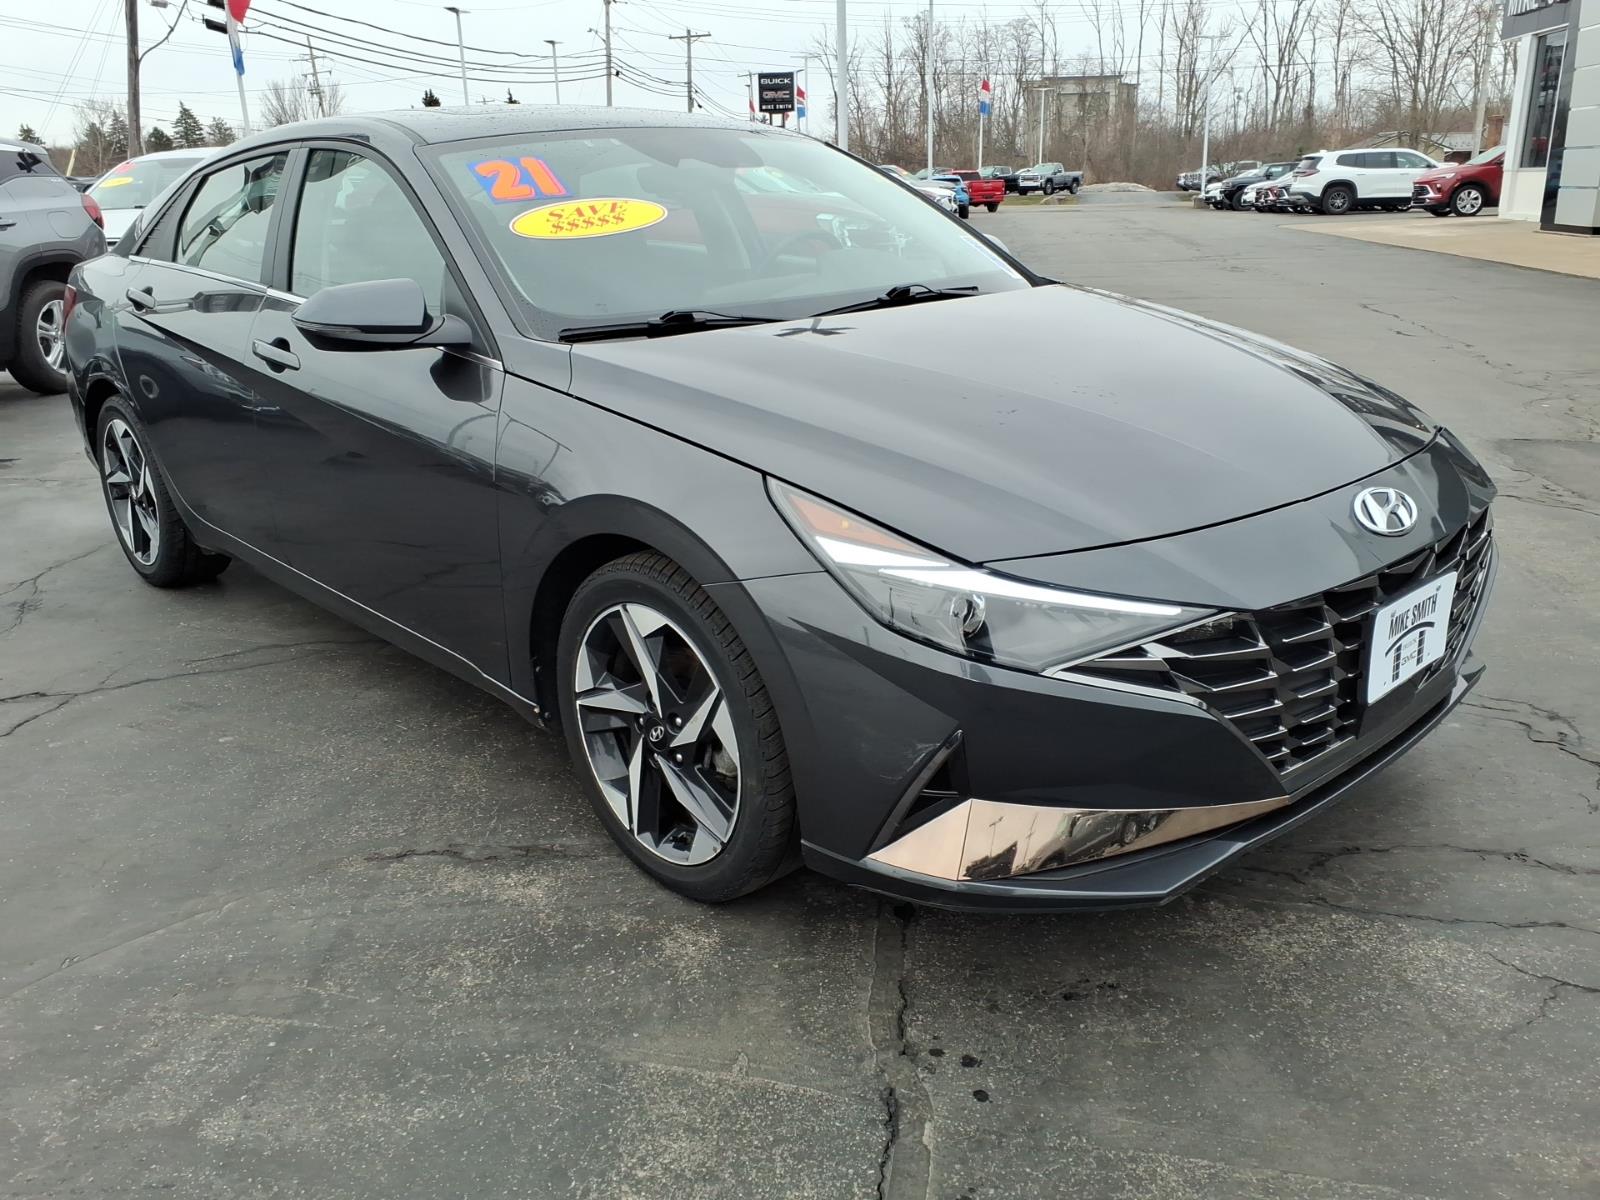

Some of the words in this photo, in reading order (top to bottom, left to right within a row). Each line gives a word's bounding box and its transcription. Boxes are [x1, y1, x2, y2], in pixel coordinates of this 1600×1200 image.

[475, 157, 567, 200] 21
[546, 200, 628, 222] SAVE
[549, 214, 625, 234] $$$$$
[1388, 608, 1410, 640] MIKE
[1411, 593, 1438, 626] SMITH
